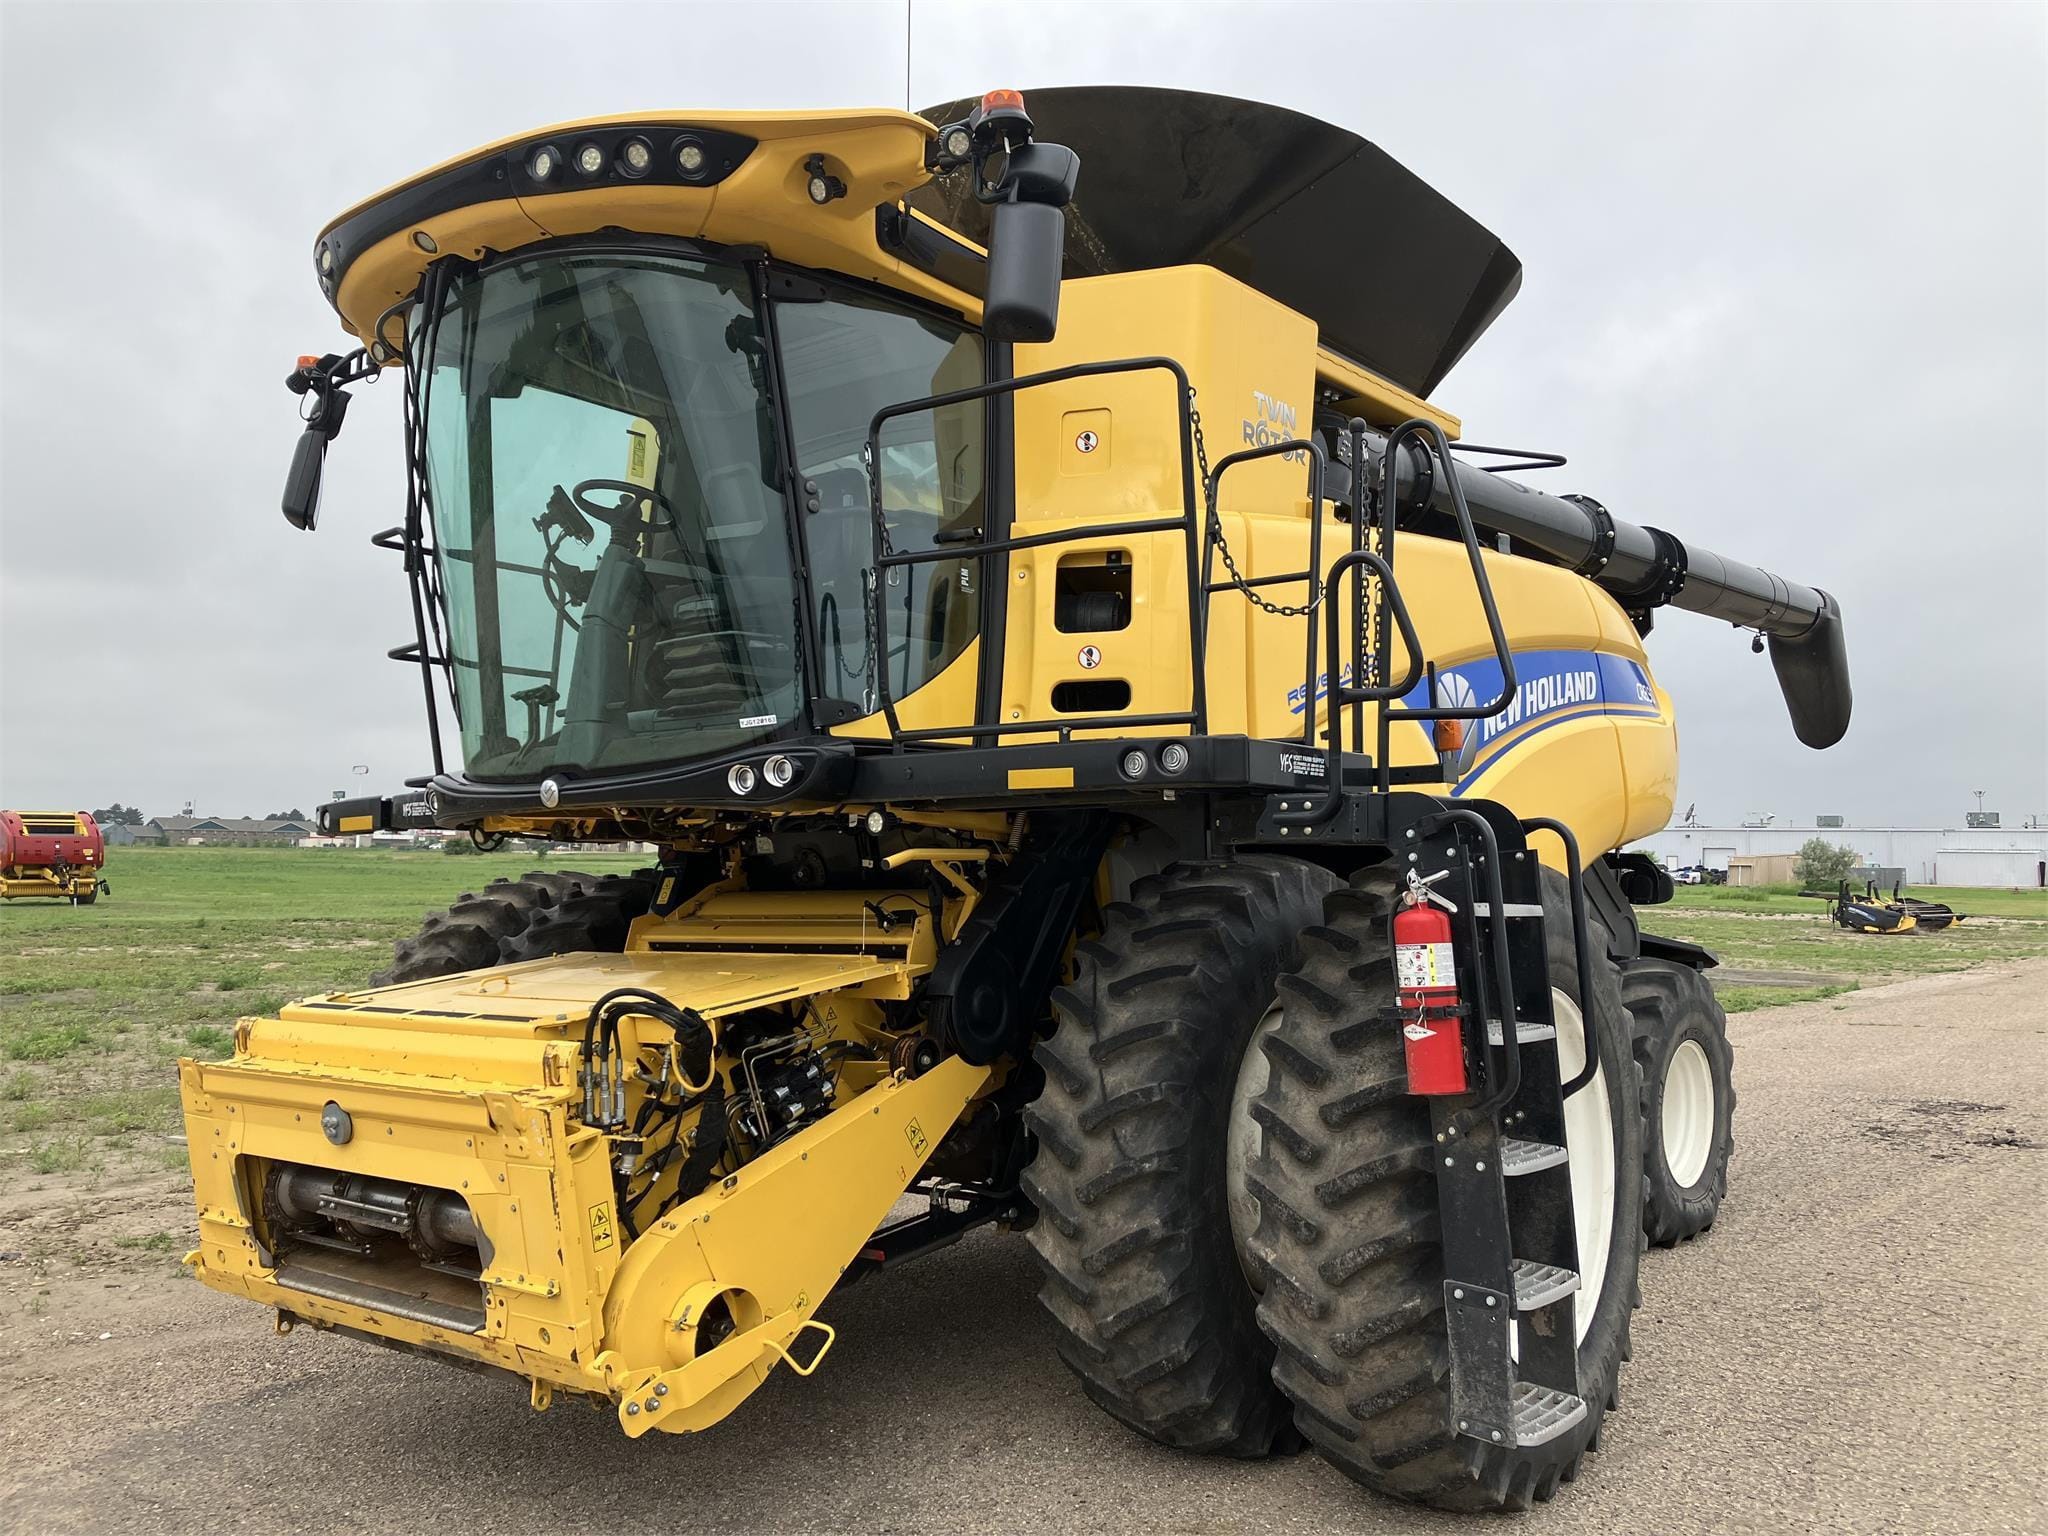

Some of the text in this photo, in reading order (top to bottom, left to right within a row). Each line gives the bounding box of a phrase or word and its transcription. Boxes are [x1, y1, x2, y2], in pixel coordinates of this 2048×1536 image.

[1253, 390, 1296, 431] TWIN
[1243, 419, 1306, 467] ROTOR
[1483, 671, 1597, 741] NEW HOLLAND
